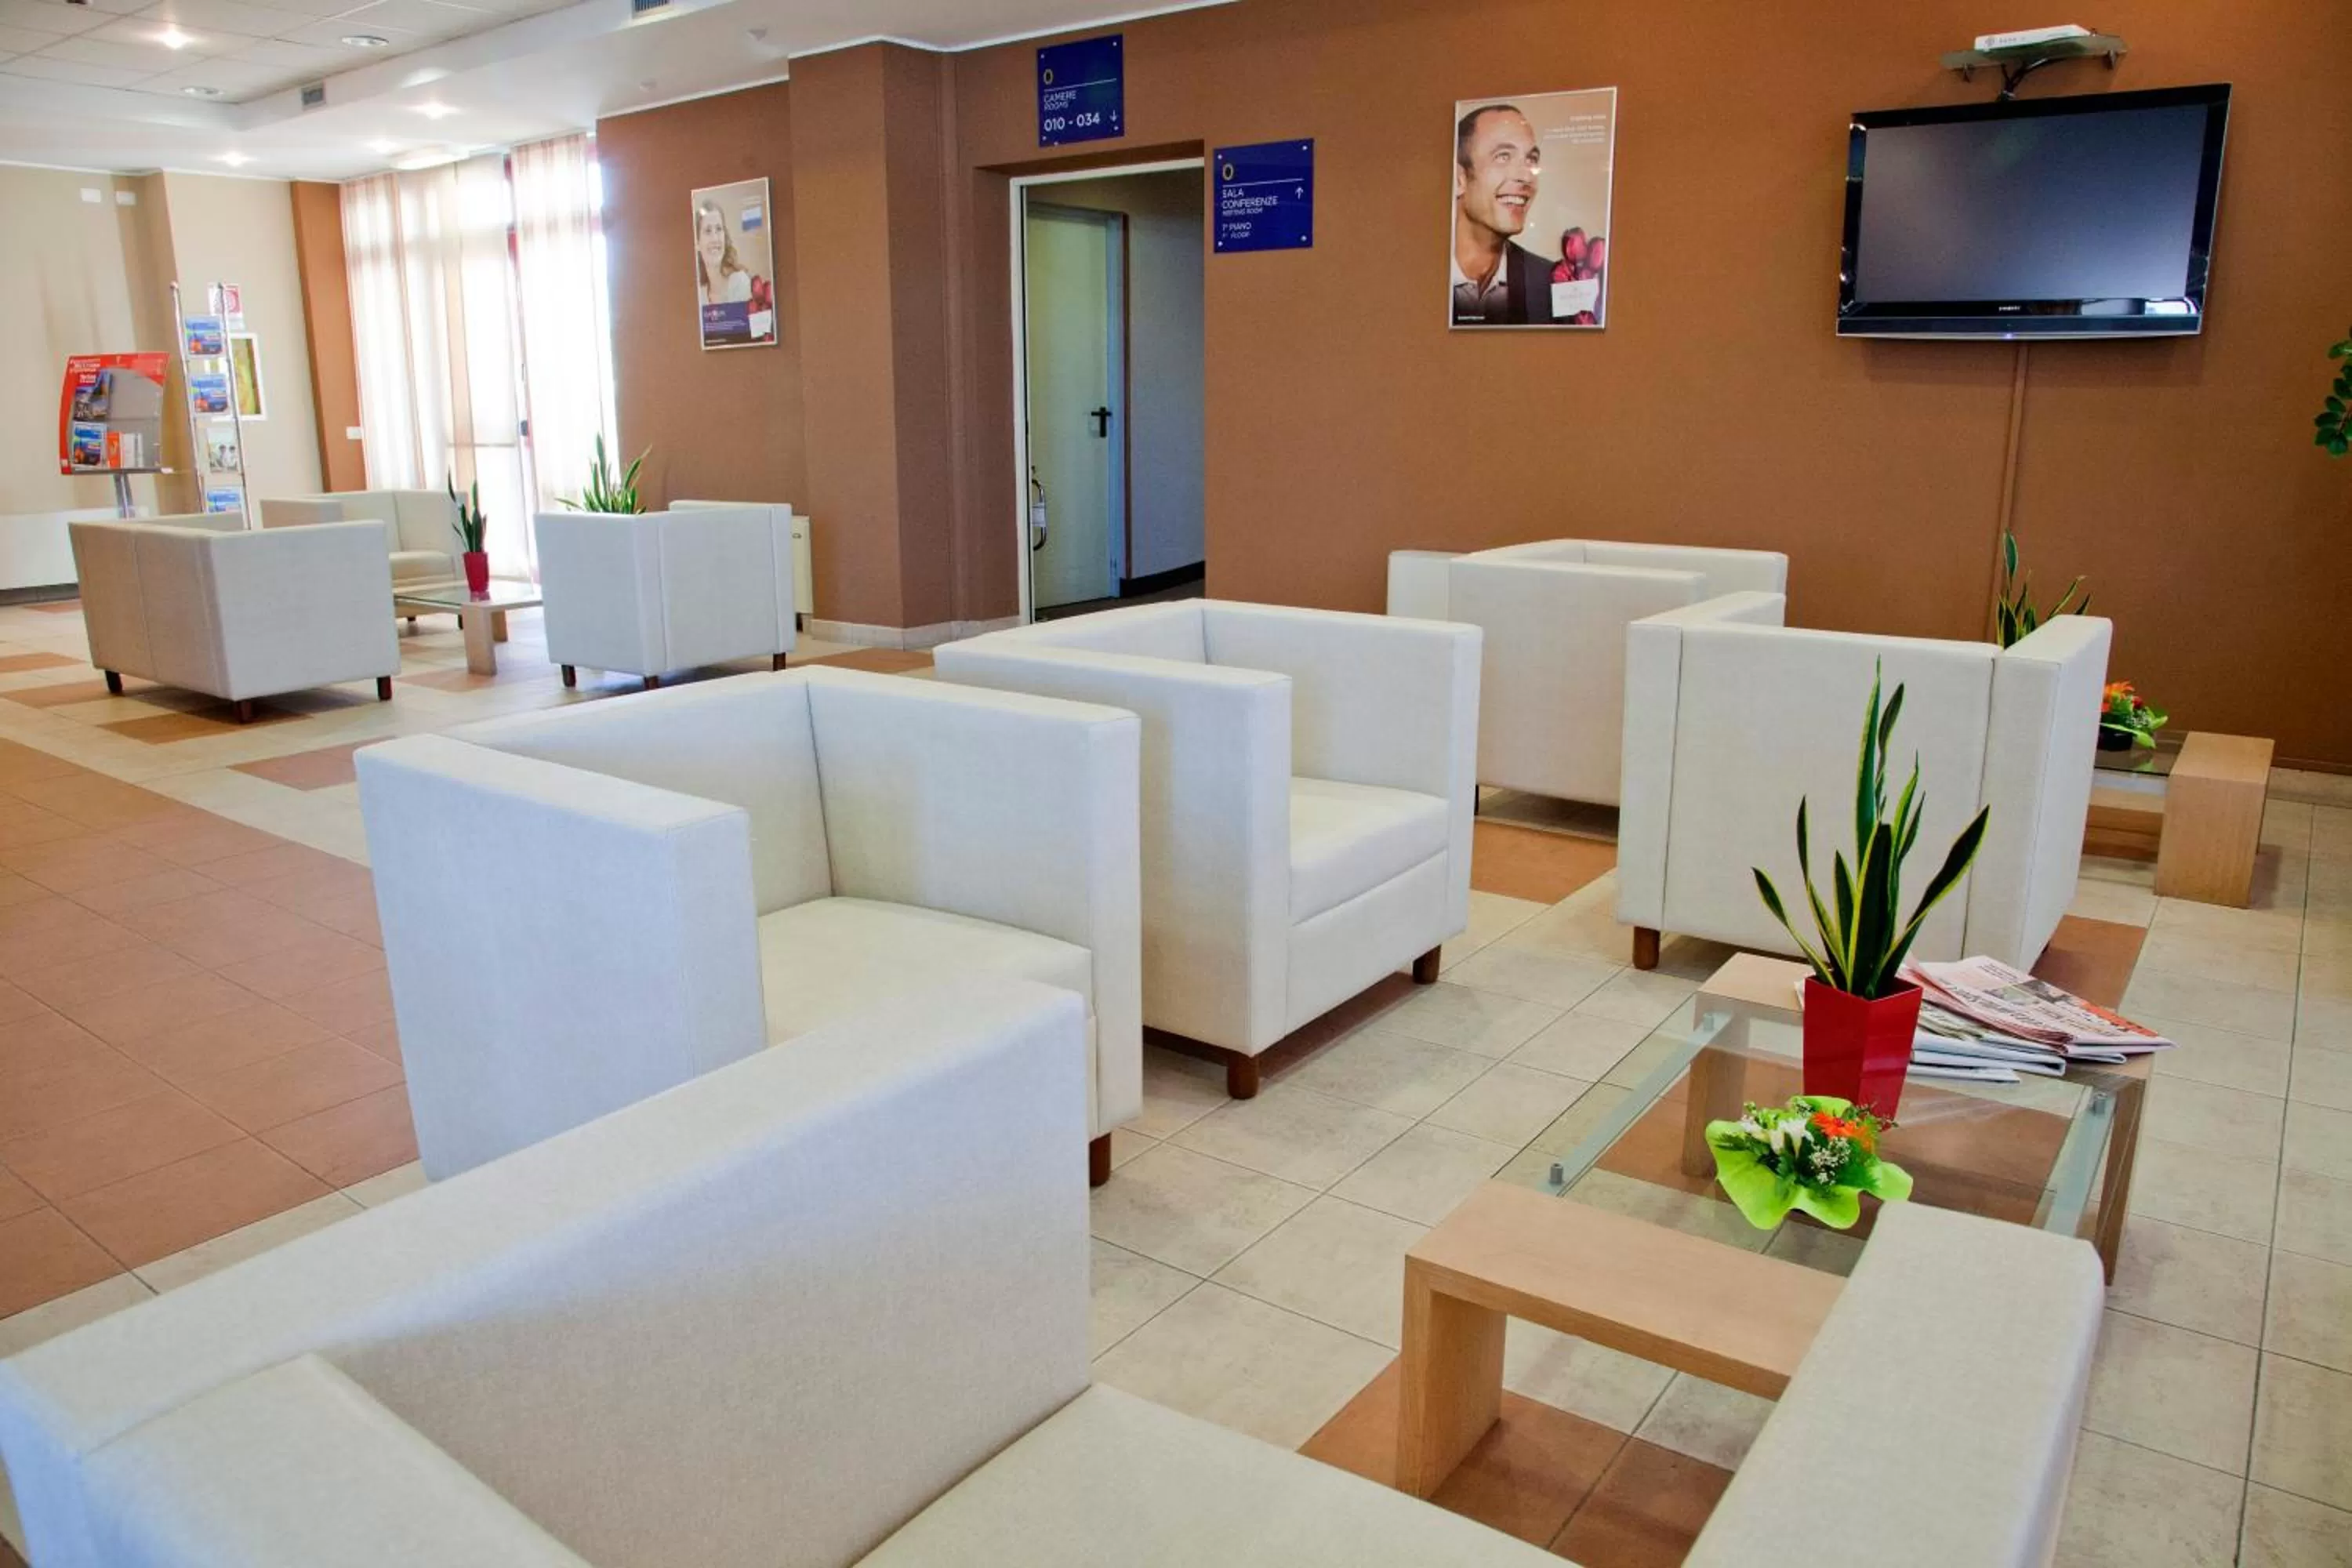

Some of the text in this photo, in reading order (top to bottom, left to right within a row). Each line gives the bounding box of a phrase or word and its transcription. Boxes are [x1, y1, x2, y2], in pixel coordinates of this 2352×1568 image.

[1044, 89, 1077, 102] CAMERE
[1044, 116, 1065, 132] 010
[1076, 112, 1101, 127] 034
[1222, 187, 1244, 198] SALA
[1222, 195, 1279, 209] CONFERENZE
[1229, 222, 1252, 230] PIANO
